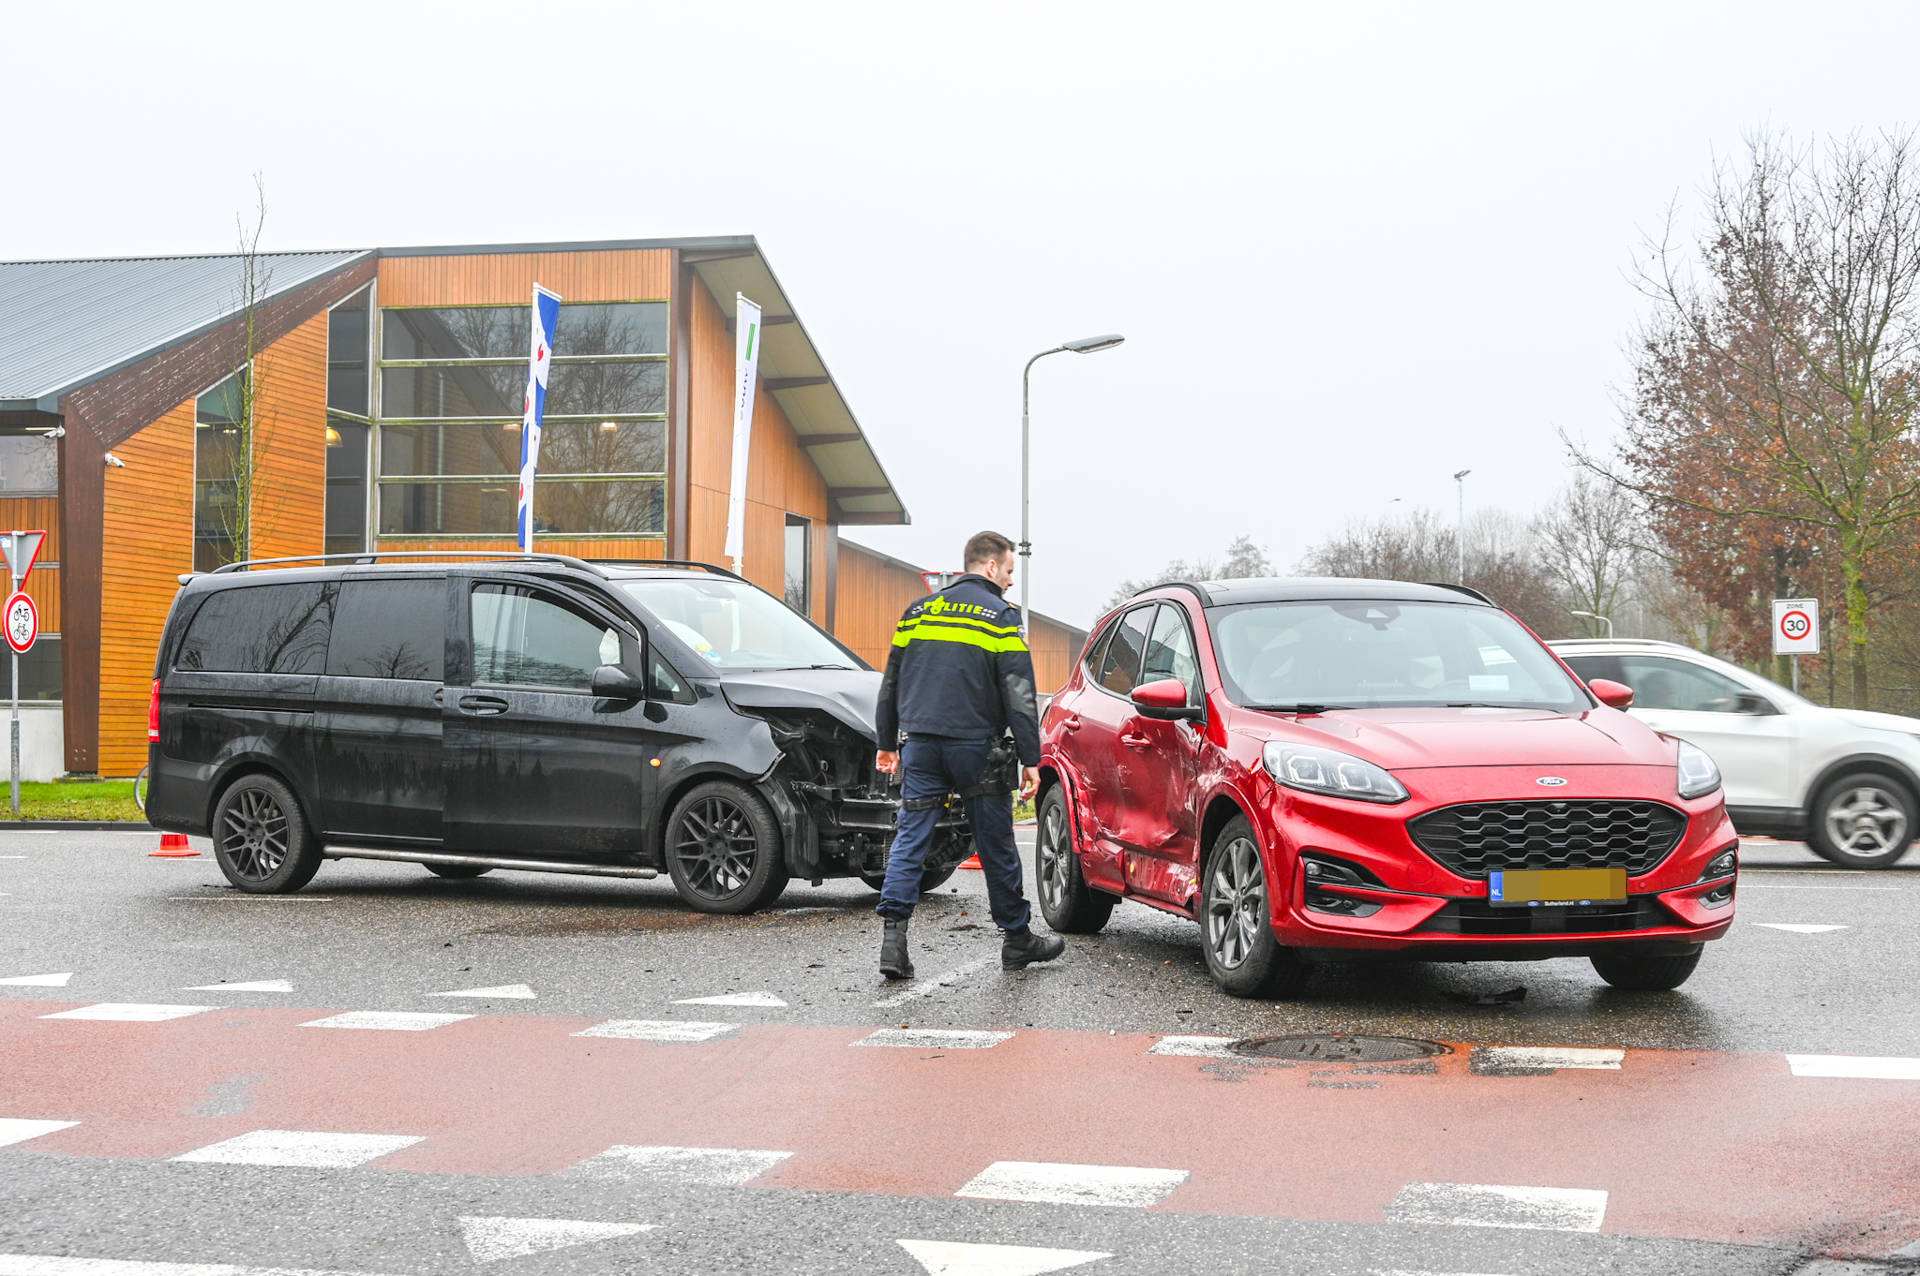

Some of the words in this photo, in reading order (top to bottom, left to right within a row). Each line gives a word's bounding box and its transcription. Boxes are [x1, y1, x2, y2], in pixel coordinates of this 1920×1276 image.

[924, 595, 984, 615] POLITIE
[1786, 619, 1806, 632] 30
[1491, 888, 1502, 897] NL
